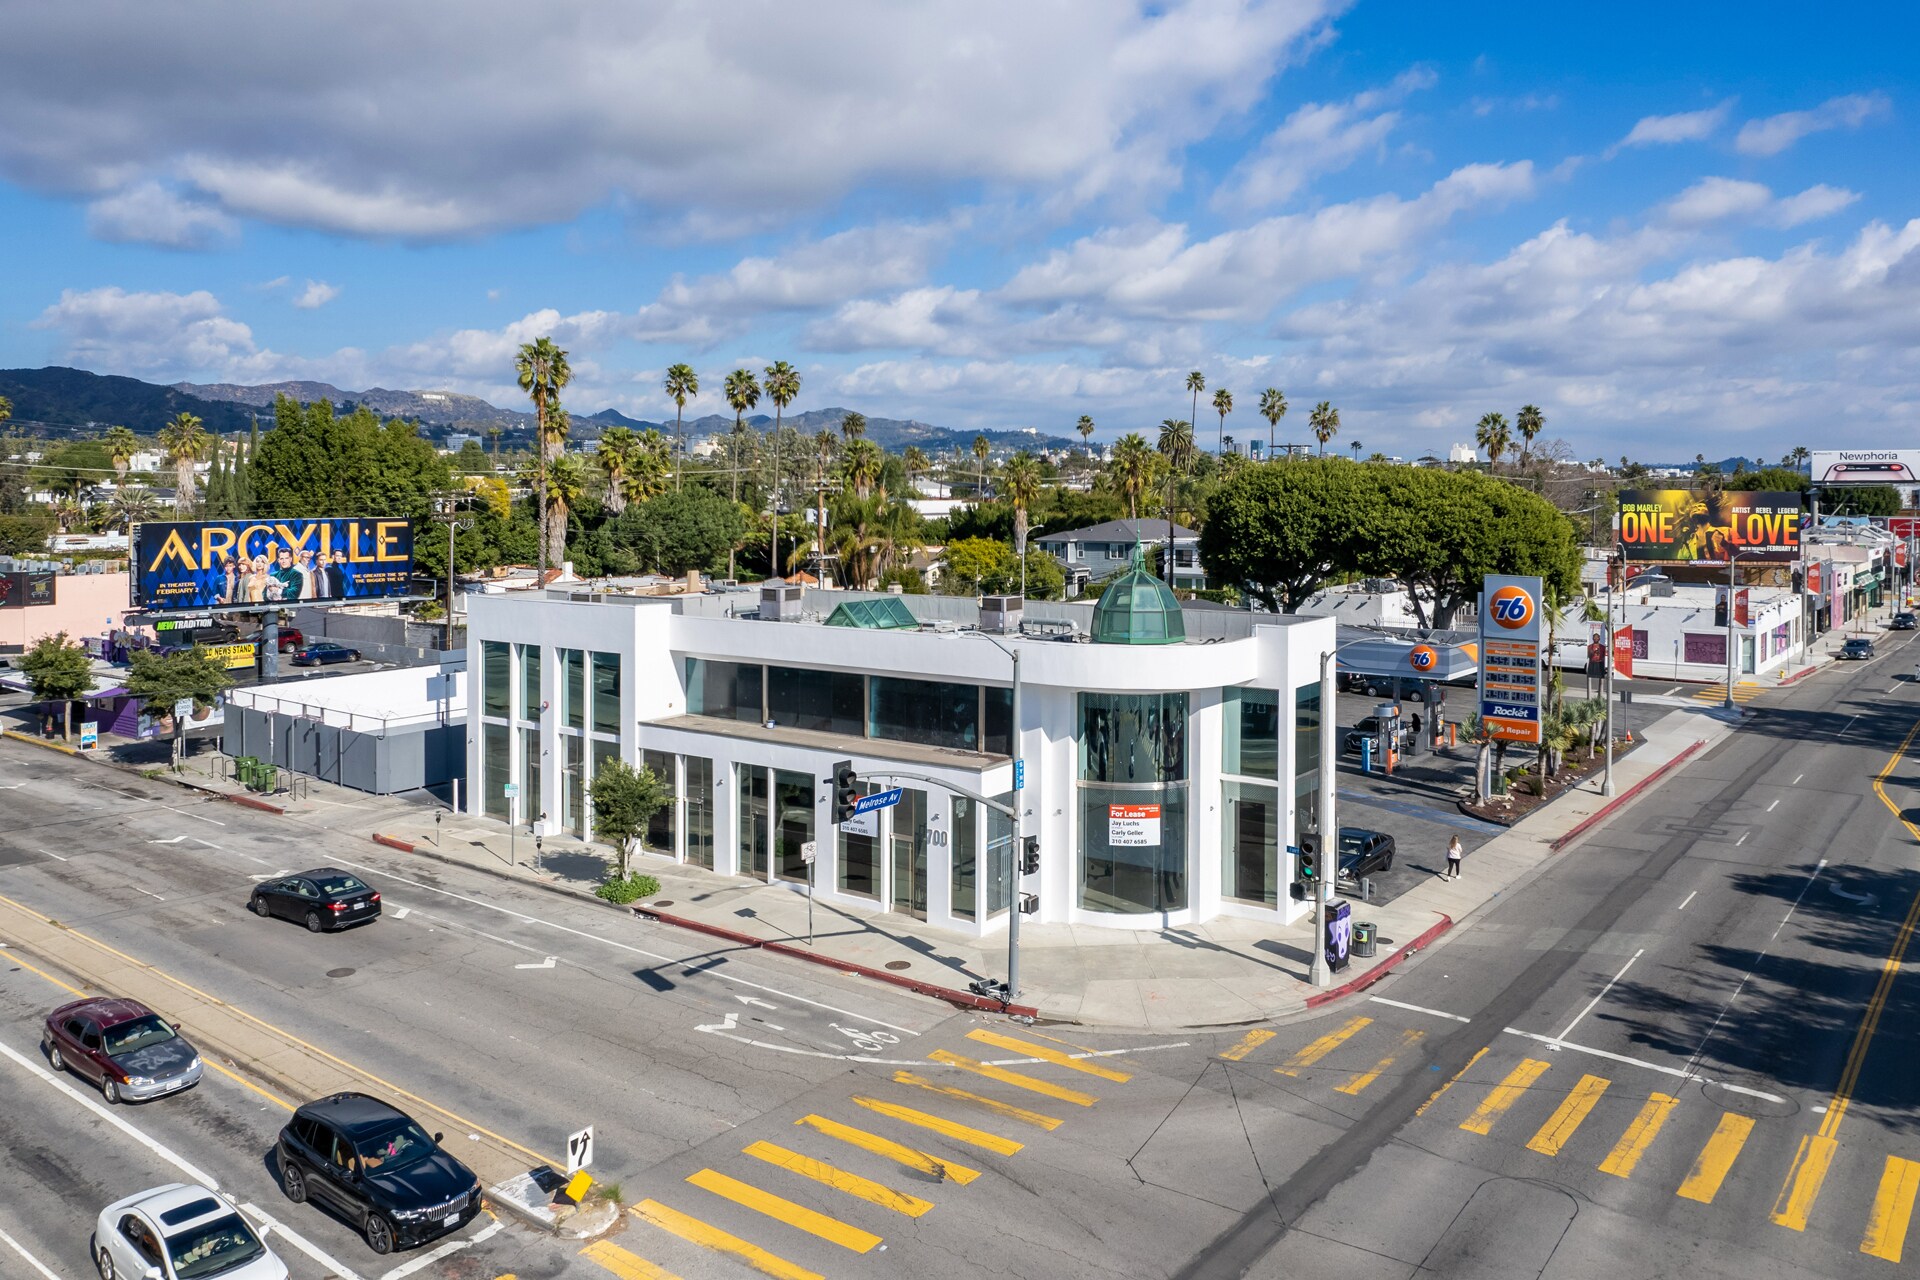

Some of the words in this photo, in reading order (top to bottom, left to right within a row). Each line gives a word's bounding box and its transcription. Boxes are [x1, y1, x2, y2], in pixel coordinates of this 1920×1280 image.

[1839, 451, 1898, 462] Newphoria
[1622, 504, 1636, 512] BOB
[1636, 504, 1663, 513] MARLEY
[1777, 507, 1799, 515] LEGEND
[1622, 512, 1674, 544] ONE
[1731, 513, 1799, 545] LOVE
[149, 522, 409, 572] ARGYLLE
[1495, 596, 1526, 620] 76
[214, 646, 231, 656] NEWS
[233, 645, 252, 655] STAND
[1413, 651, 1431, 666] 76
[1506, 726, 1531, 735] Repair
[859, 796, 887, 810] Melrose
[888, 793, 898, 802] Av
